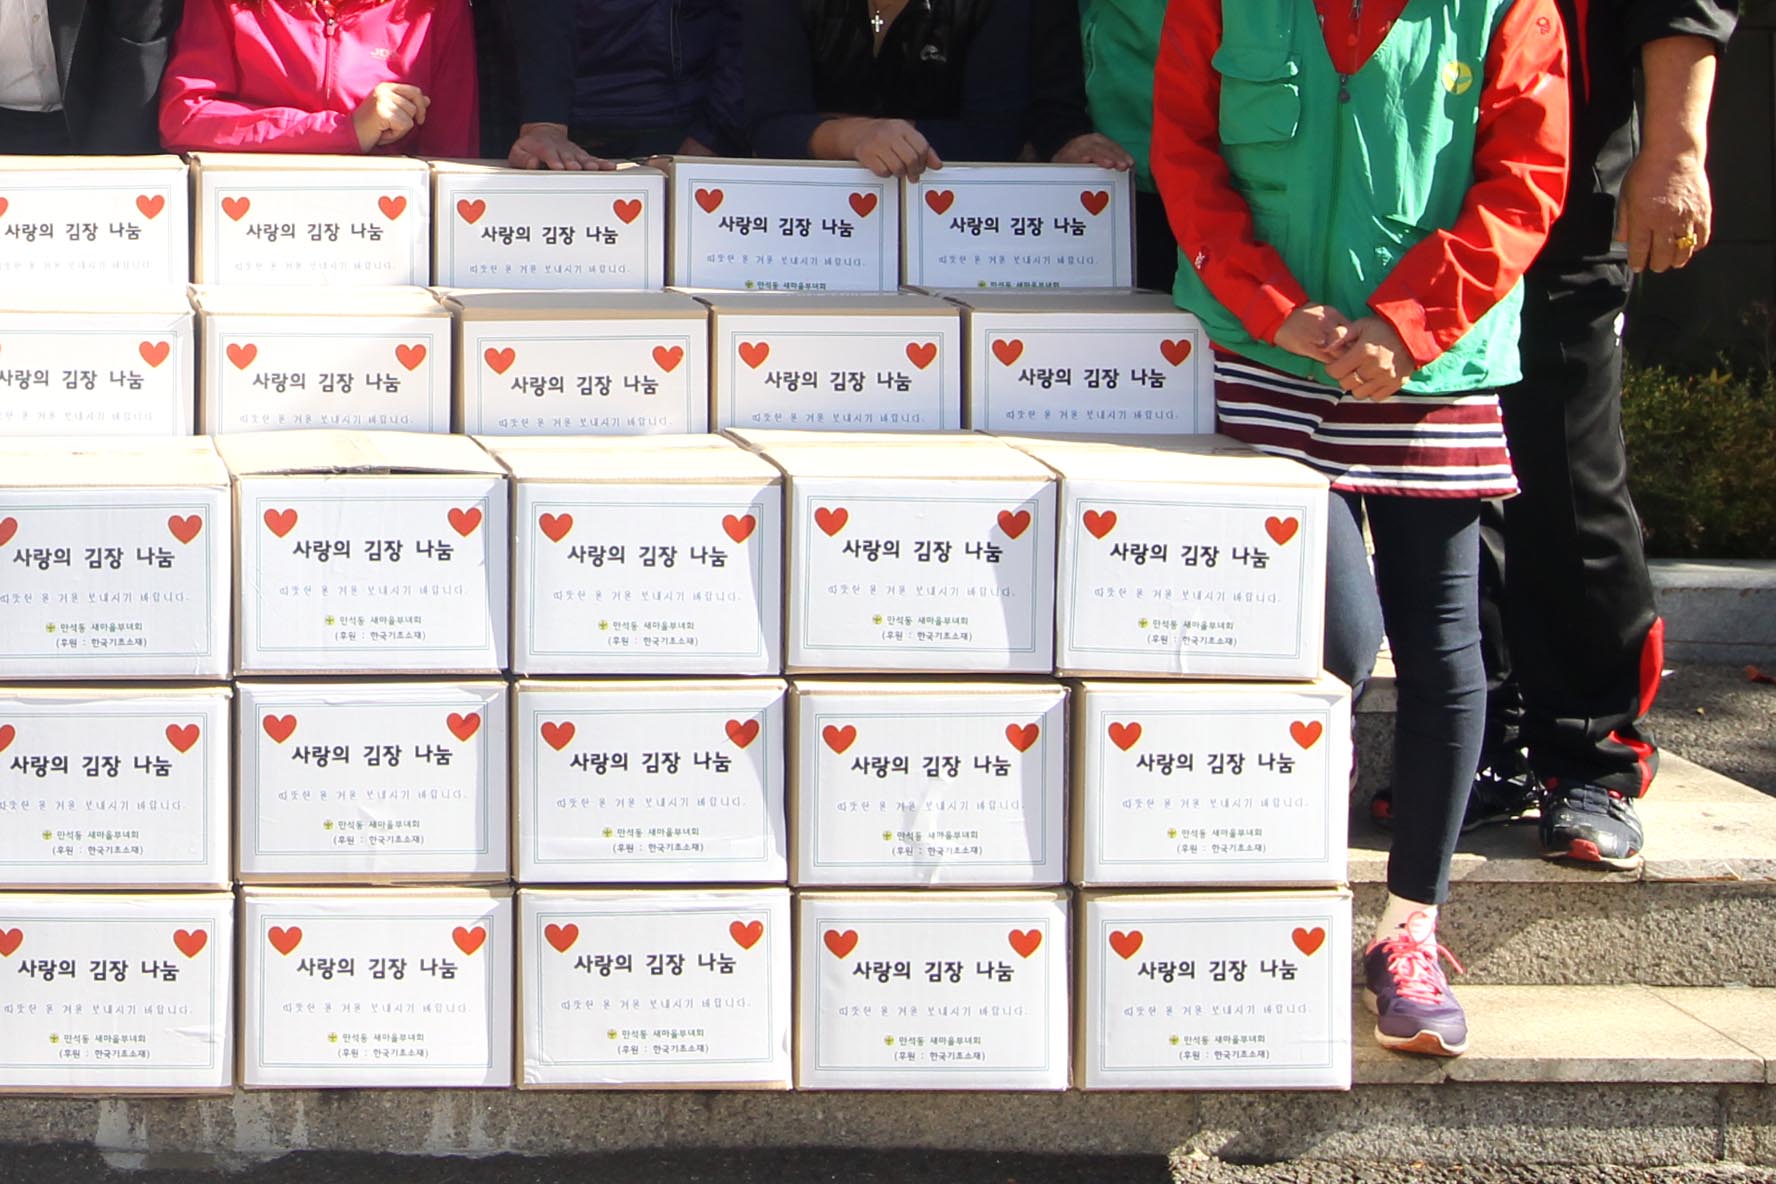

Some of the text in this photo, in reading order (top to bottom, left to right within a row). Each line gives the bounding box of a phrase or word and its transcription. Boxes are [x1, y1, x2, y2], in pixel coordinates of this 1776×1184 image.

[4, 222, 142, 243] 사랑의 김장 나눔
[481, 225, 619, 246] 사랑의 김장 나눔
[718, 215, 855, 238] 사랑의 김장 나눔
[949, 216, 1087, 237] 사랑의 김장 나눔
[62, 369, 98, 391] 김장
[109, 370, 145, 390] 나눔
[252, 372, 401, 394] 사랑의 김장 나눔
[764, 371, 913, 393] 사랑의 김장 나눔
[1018, 368, 1167, 390] 사랑의 김장 나눔
[12, 546, 175, 571] 사랑의 김장 나눔
[292, 539, 454, 563] 사랑의 김장 나눔
[567, 545, 729, 569] 사랑의 김장 나눔
[1109, 542, 1270, 569] 사랑의 김장 나눔
[9, 755, 173, 778] 사랑의 김장 나눔
[291, 744, 453, 768] 사랑의 김장 나눔
[850, 755, 1012, 779] 사랑의 김장 나눔
[1136, 752, 1296, 776] 사랑의 김장 나눔
[17, 959, 180, 983] 사랑의 김장 나눔
[296, 957, 458, 981] 사랑의 김장 나눔
[852, 961, 1015, 984] 사랑의 김장 나눔
[1137, 959, 1298, 984] 사랑의 김장 나눔
